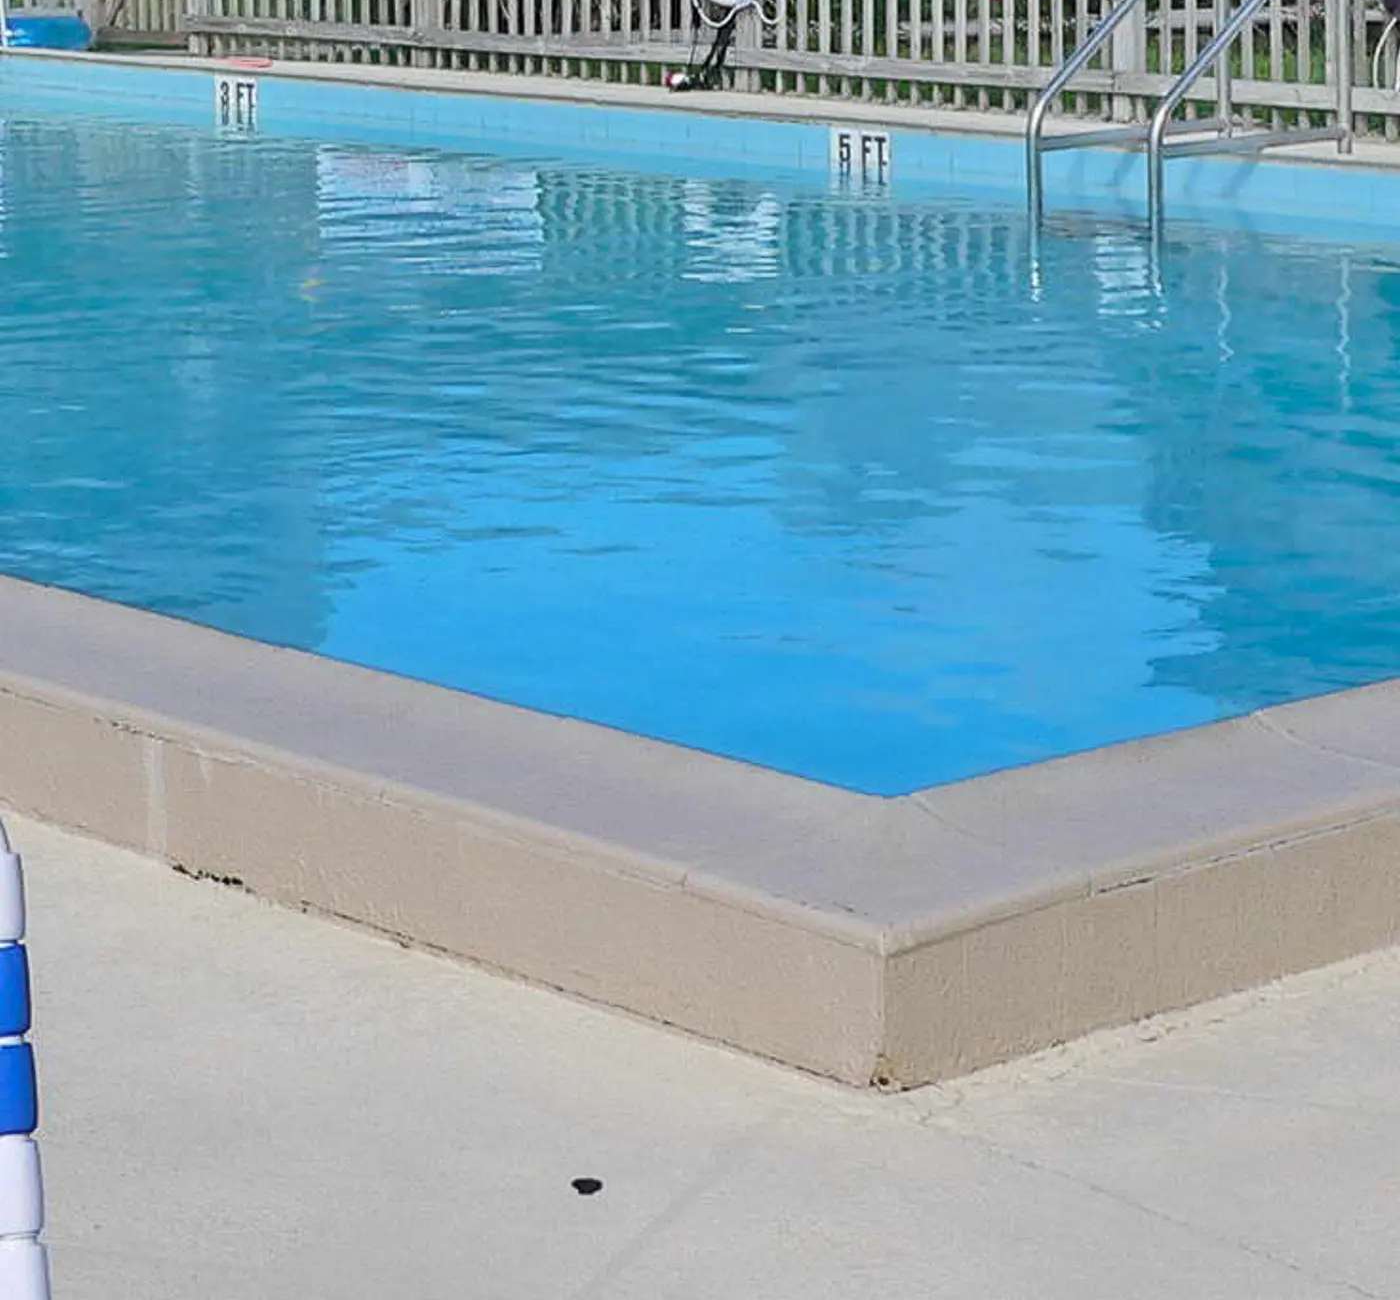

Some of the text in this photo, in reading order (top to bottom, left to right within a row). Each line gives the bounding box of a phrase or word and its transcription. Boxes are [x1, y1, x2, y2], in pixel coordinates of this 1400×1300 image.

[236, 82, 255, 106] FT
[838, 133, 887, 165] 5 FT
